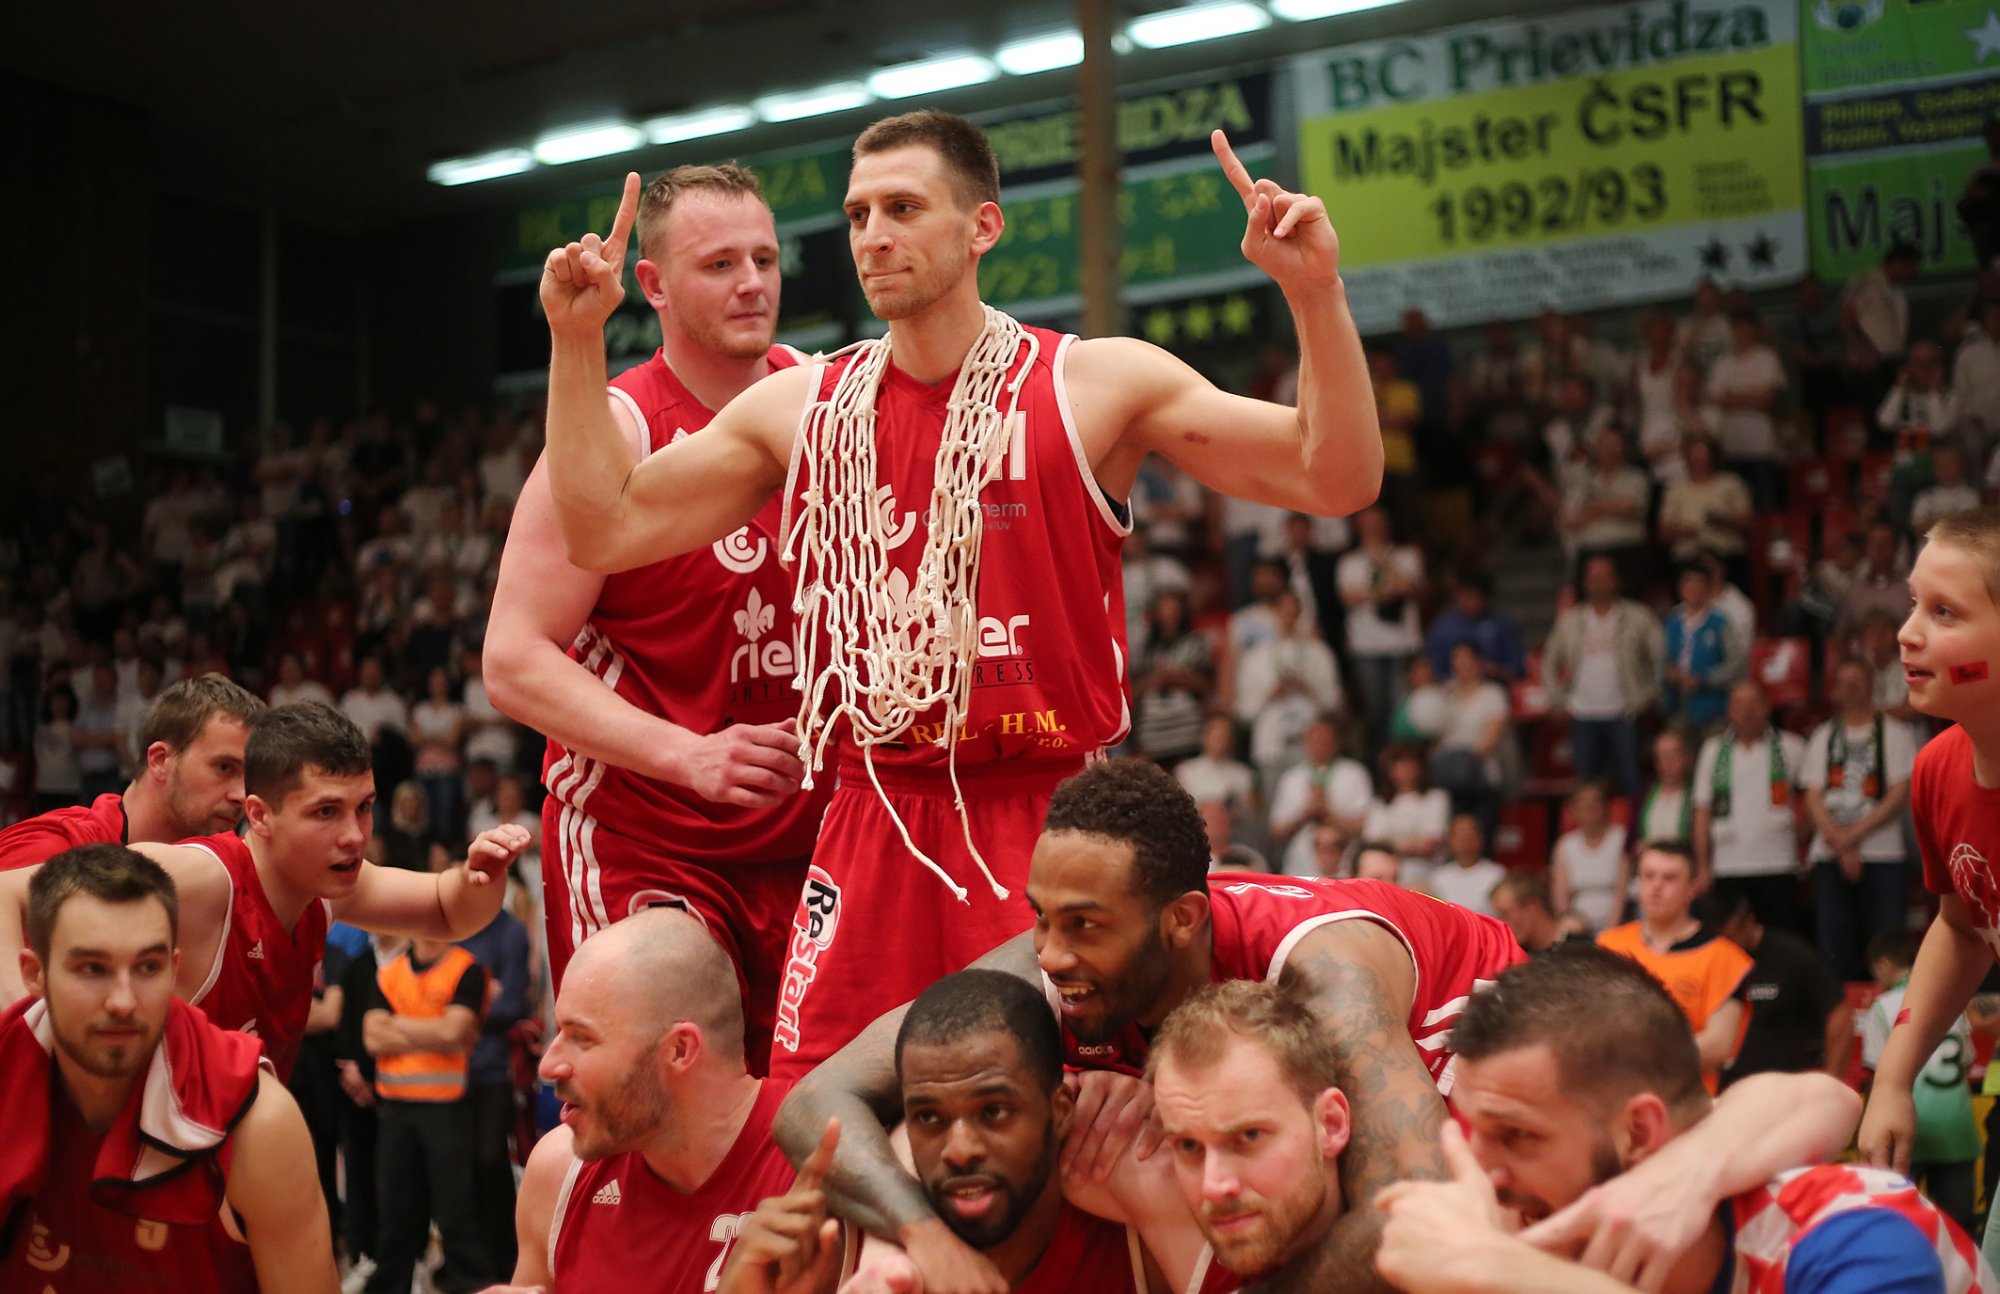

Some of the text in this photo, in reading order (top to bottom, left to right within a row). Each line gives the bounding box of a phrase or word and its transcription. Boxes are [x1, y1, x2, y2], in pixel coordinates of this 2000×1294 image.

[1327, 3, 1768, 112] BC Prievidza
[1333, 68, 1766, 184] Majster ČSFR
[1432, 162, 1669, 243] 1992/93
[1824, 178, 1968, 264] Maj
[703, 1211, 758, 1293] 2
